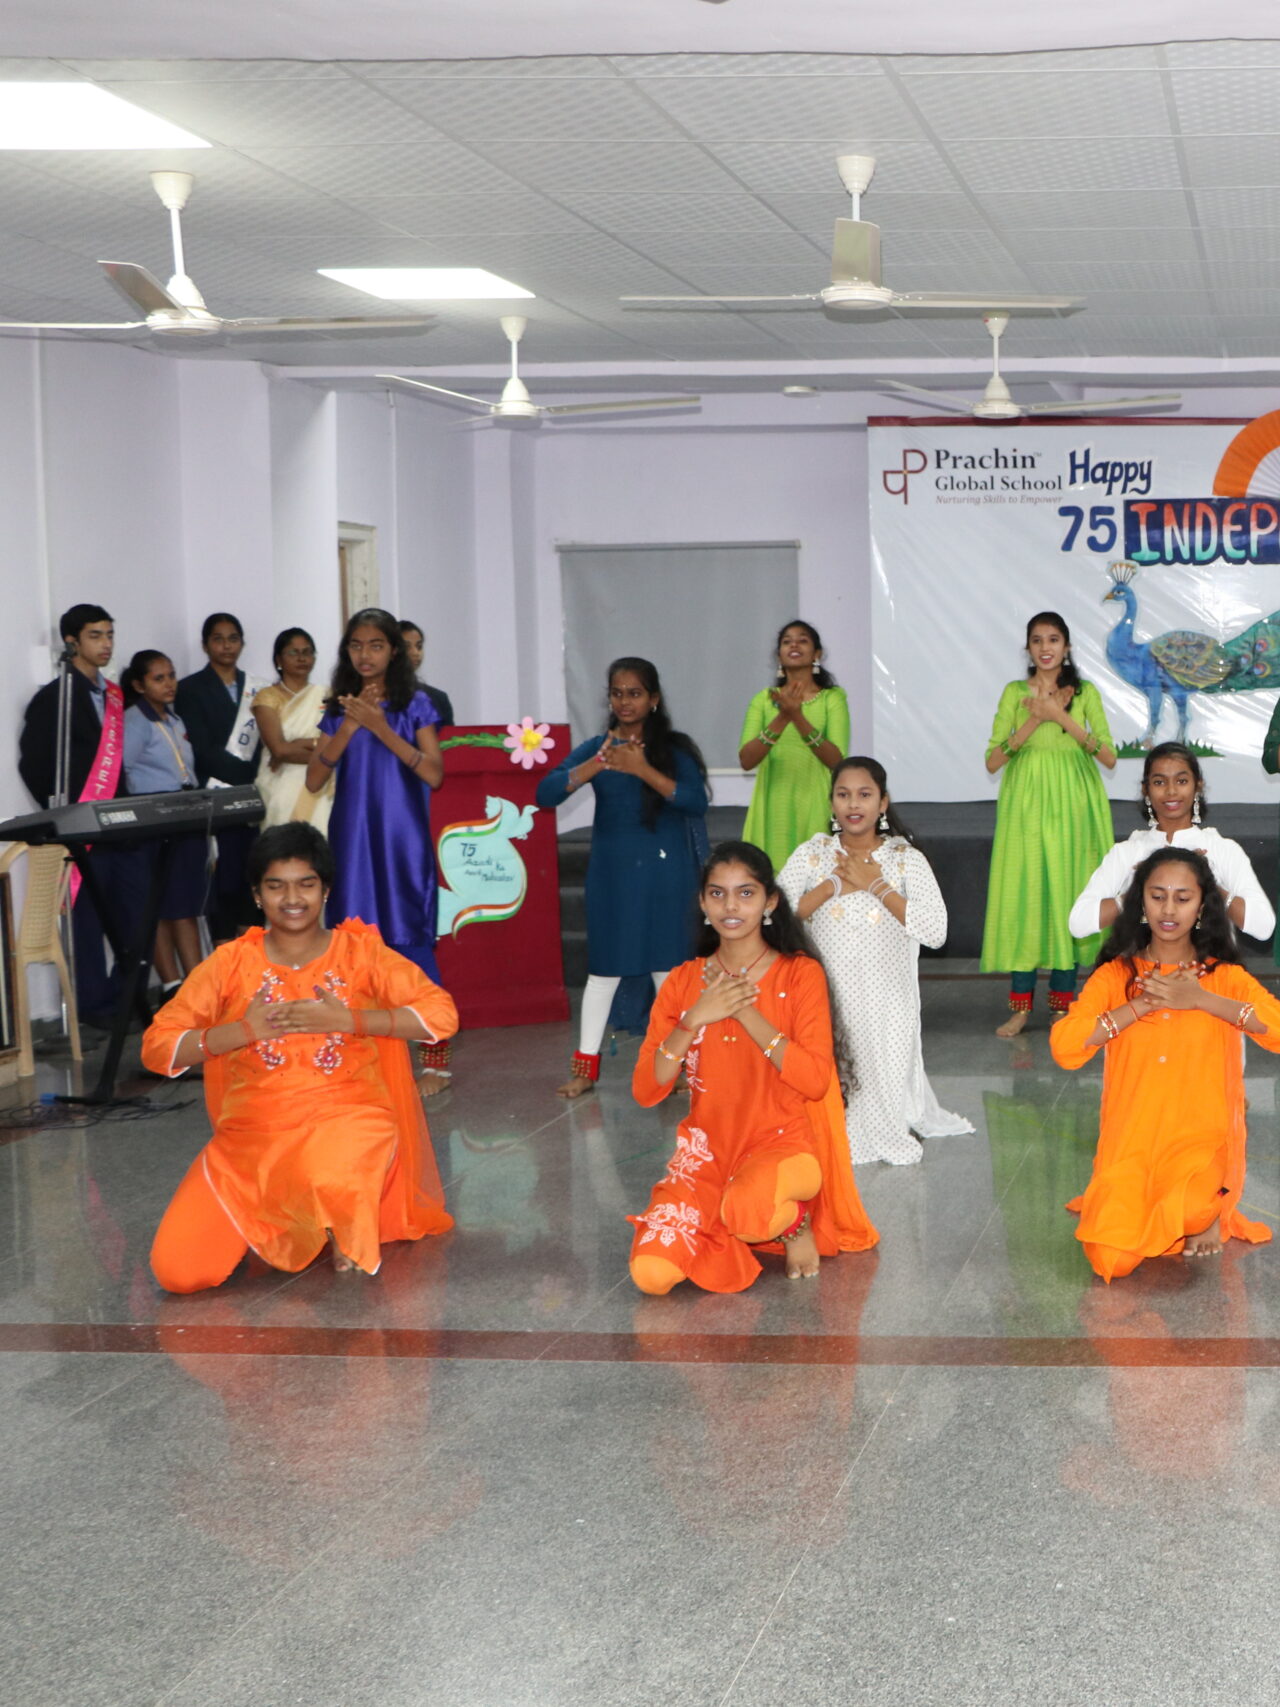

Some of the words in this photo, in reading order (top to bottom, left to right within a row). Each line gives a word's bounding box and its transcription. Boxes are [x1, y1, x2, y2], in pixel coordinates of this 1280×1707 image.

[935, 448, 1036, 469] Prachin
[1068, 447, 1153, 496] Happy
[935, 475, 995, 491] Global
[1000, 475, 1062, 491] School
[936, 495, 981, 506] Nurturing
[982, 494, 1006, 504] Skills
[1008, 496, 1018, 504] to
[1020, 495, 1063, 506] Empower
[1058, 505, 1118, 553] 75
[94, 715, 117, 802] SECRET
[460, 842, 478, 857] 75
